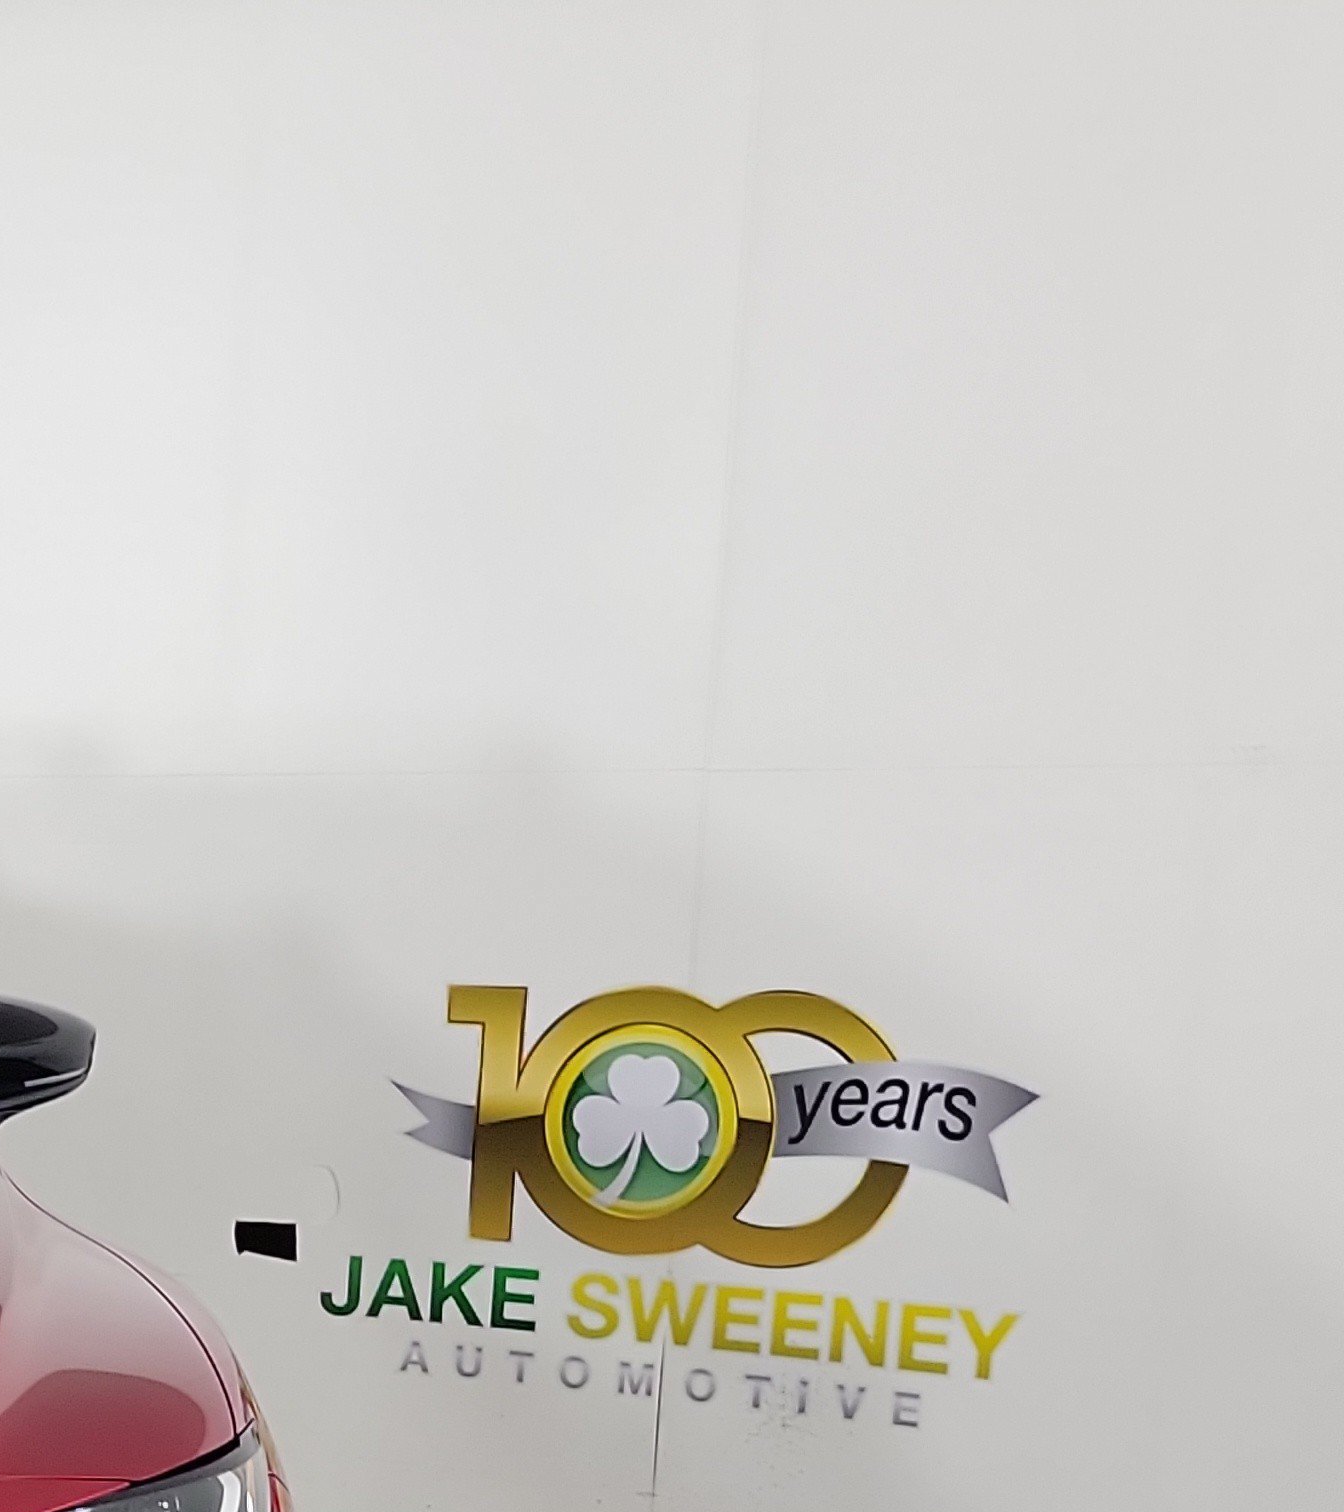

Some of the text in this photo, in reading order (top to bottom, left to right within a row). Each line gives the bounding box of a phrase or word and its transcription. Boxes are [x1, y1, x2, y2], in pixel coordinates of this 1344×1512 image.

[787, 1073, 978, 1144] years
[319, 1254, 1019, 1381] JAKE SWEENEY
[399, 1341, 923, 1428] AUTOMOTIVE
